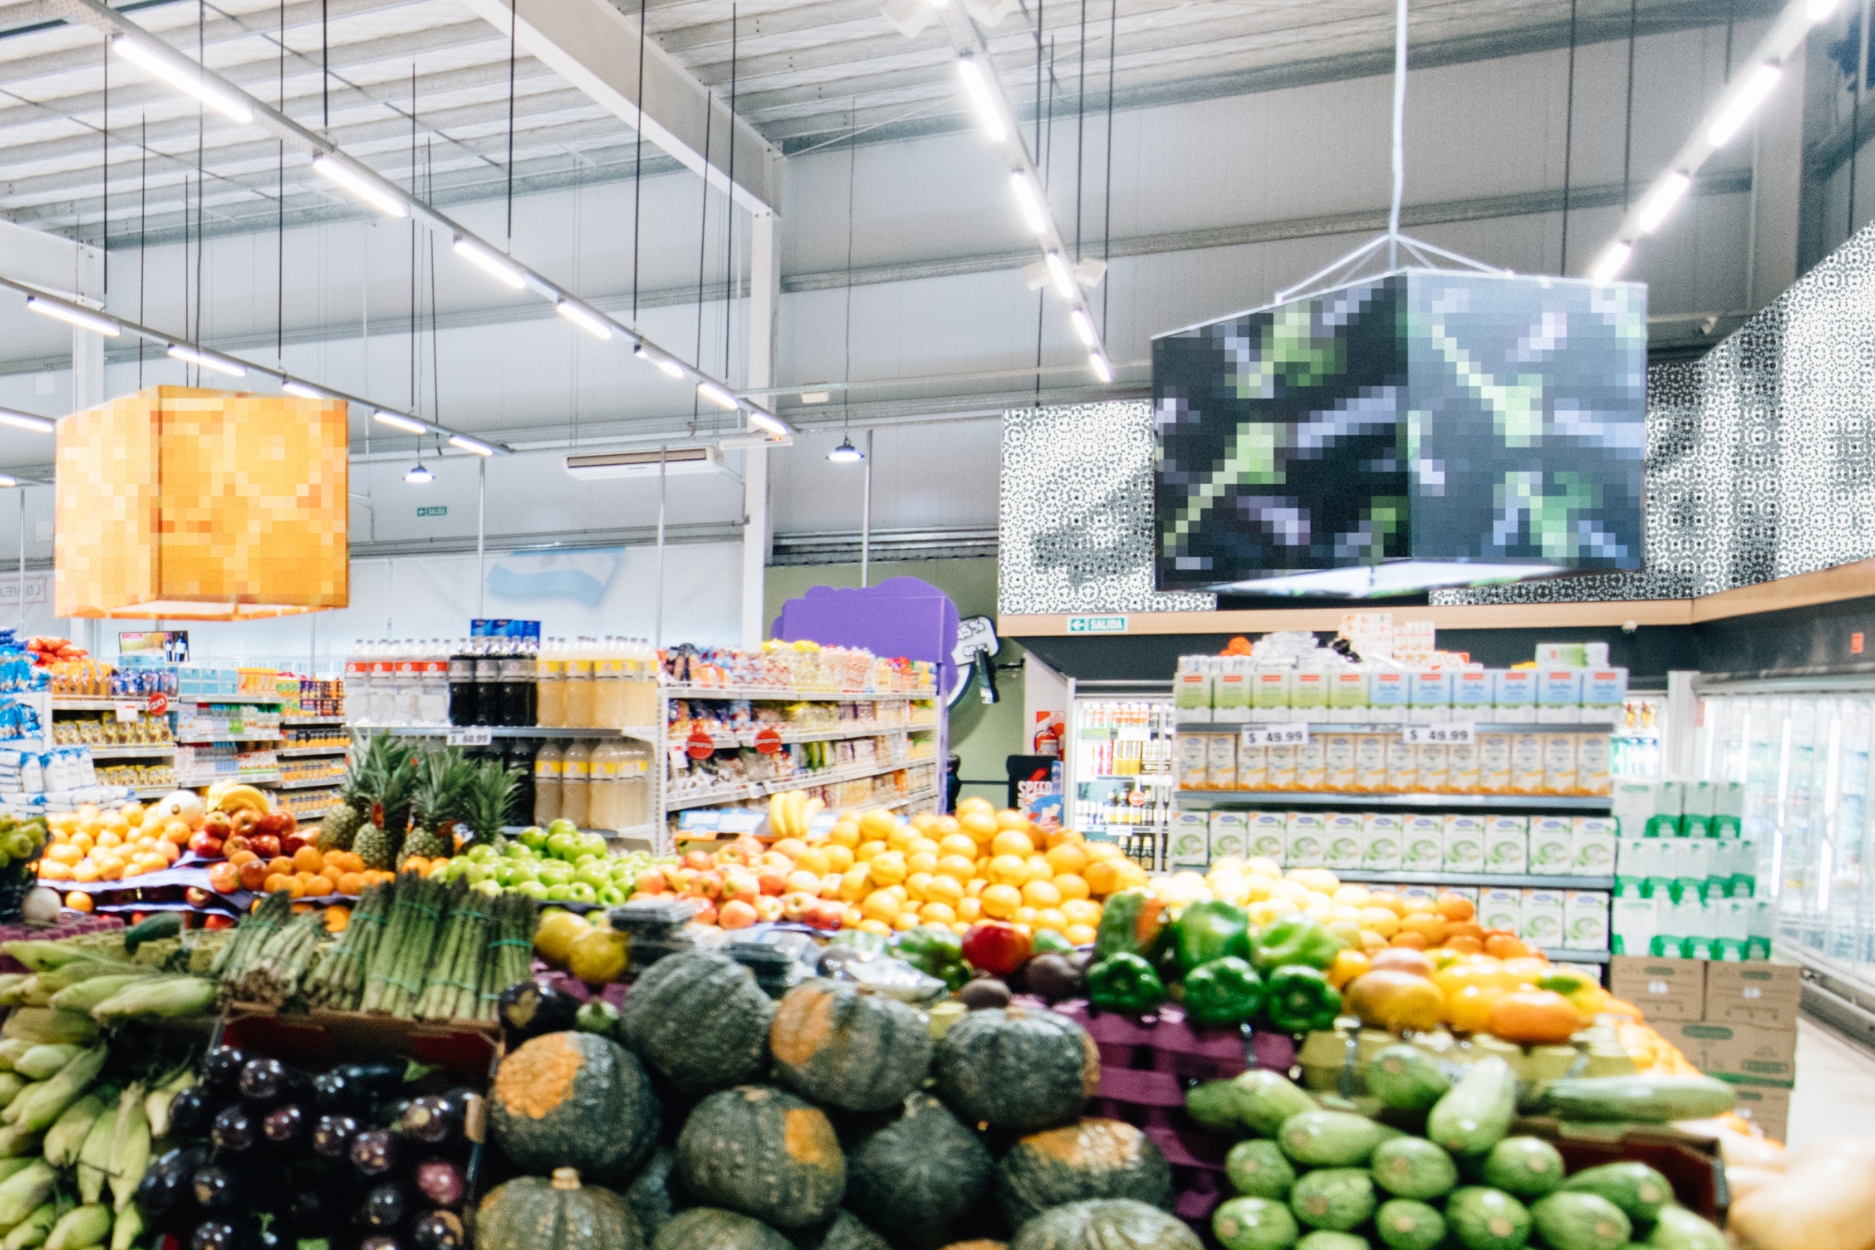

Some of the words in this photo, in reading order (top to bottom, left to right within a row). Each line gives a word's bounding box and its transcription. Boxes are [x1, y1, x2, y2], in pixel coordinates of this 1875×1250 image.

[1089, 619, 1124, 630] SALIDA
[1249, 732, 1256, 744] $
[1266, 731, 1303, 743] 49.99
[1410, 730, 1417, 741] $
[1428, 730, 1469, 741] 49.99
